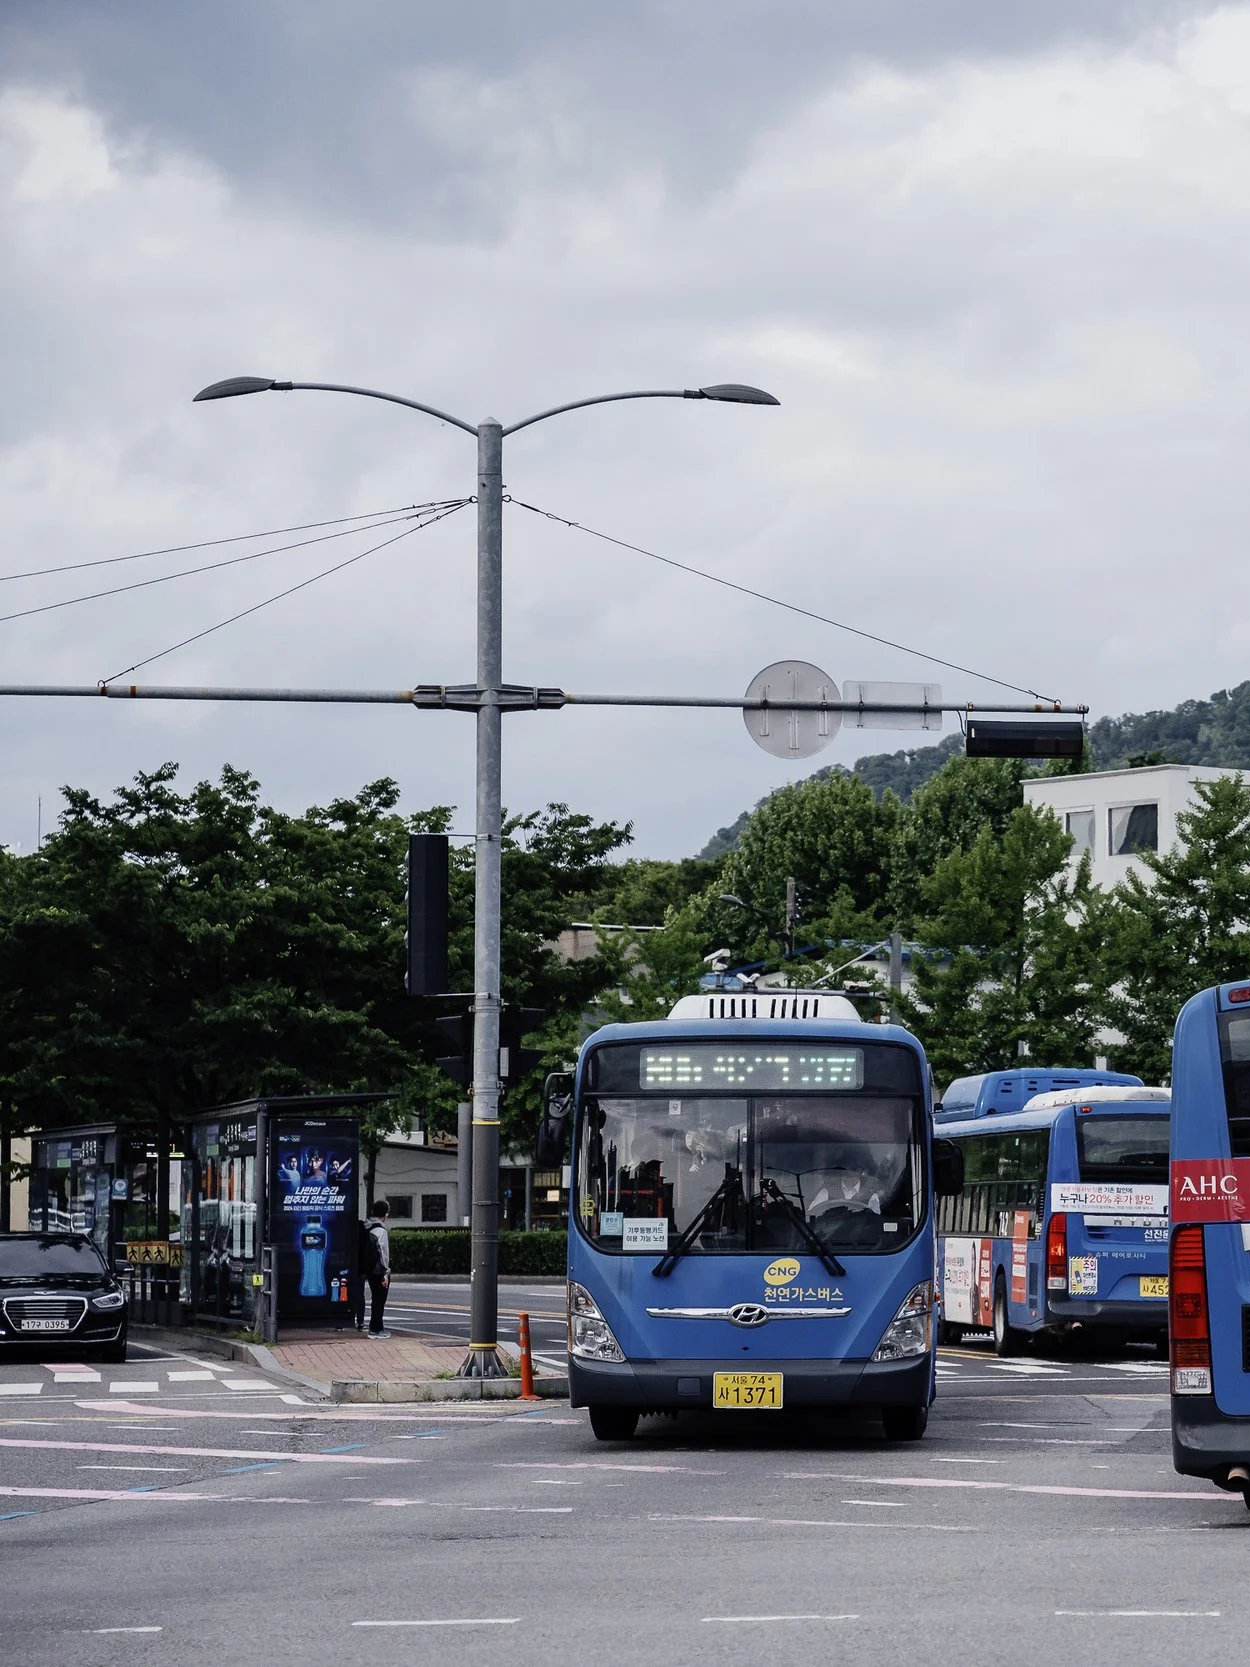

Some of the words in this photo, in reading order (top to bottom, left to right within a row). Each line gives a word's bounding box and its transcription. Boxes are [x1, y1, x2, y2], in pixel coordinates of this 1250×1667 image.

[1180, 1175, 1238, 1195] AHC
[295, 1186, 321, 1195] 나만의
[321, 1186, 339, 1195] 순간
[283, 1195, 309, 1204] 멈추지
[309, 1196, 327, 1204] 않는
[327, 1195, 346, 1204] 파워
[1060, 1193, 1088, 1204] 누구나
[1090, 1194, 1112, 1203] 20%
[1114, 1194, 1133, 1204] 추가
[1135, 1195, 1154, 1205] 할인
[767, 1267, 796, 1276] CNG
[764, 1287, 844, 1302] 천연가스버스
[731, 1376, 748, 1385] 서울
[750, 1376, 765, 1384] 74
[718, 1387, 776, 1404] 사1371
